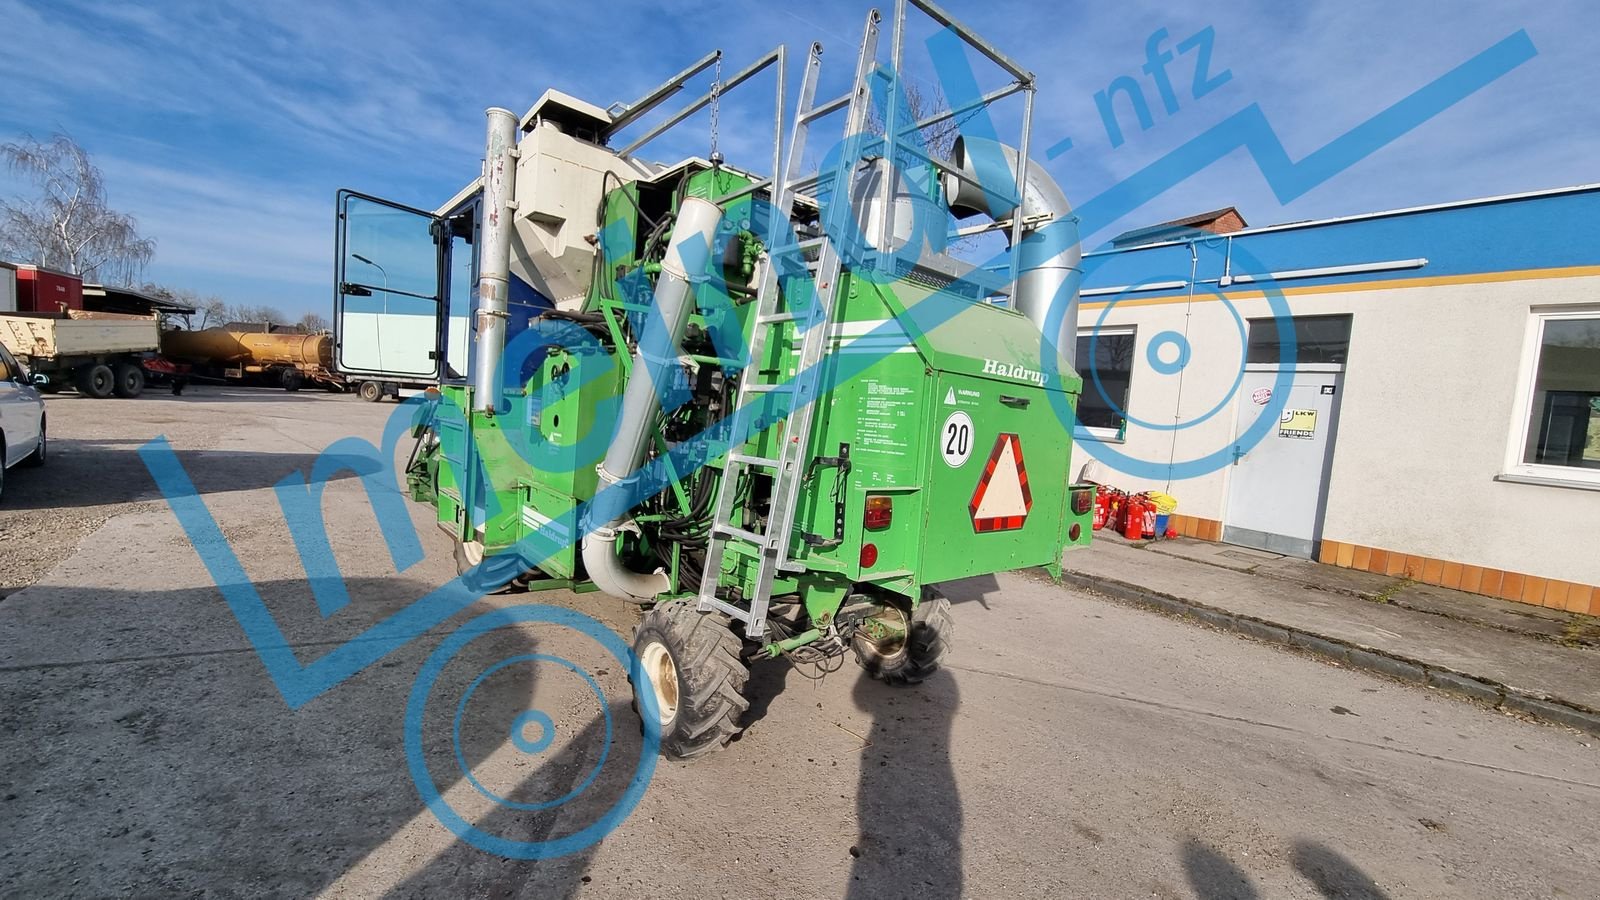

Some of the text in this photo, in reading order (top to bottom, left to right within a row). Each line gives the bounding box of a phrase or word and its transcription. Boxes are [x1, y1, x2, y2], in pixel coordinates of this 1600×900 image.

[982, 358, 1050, 387] Haldrup
[946, 422, 969, 456] 20
[1279, 429, 1314, 437] FRIENDS
